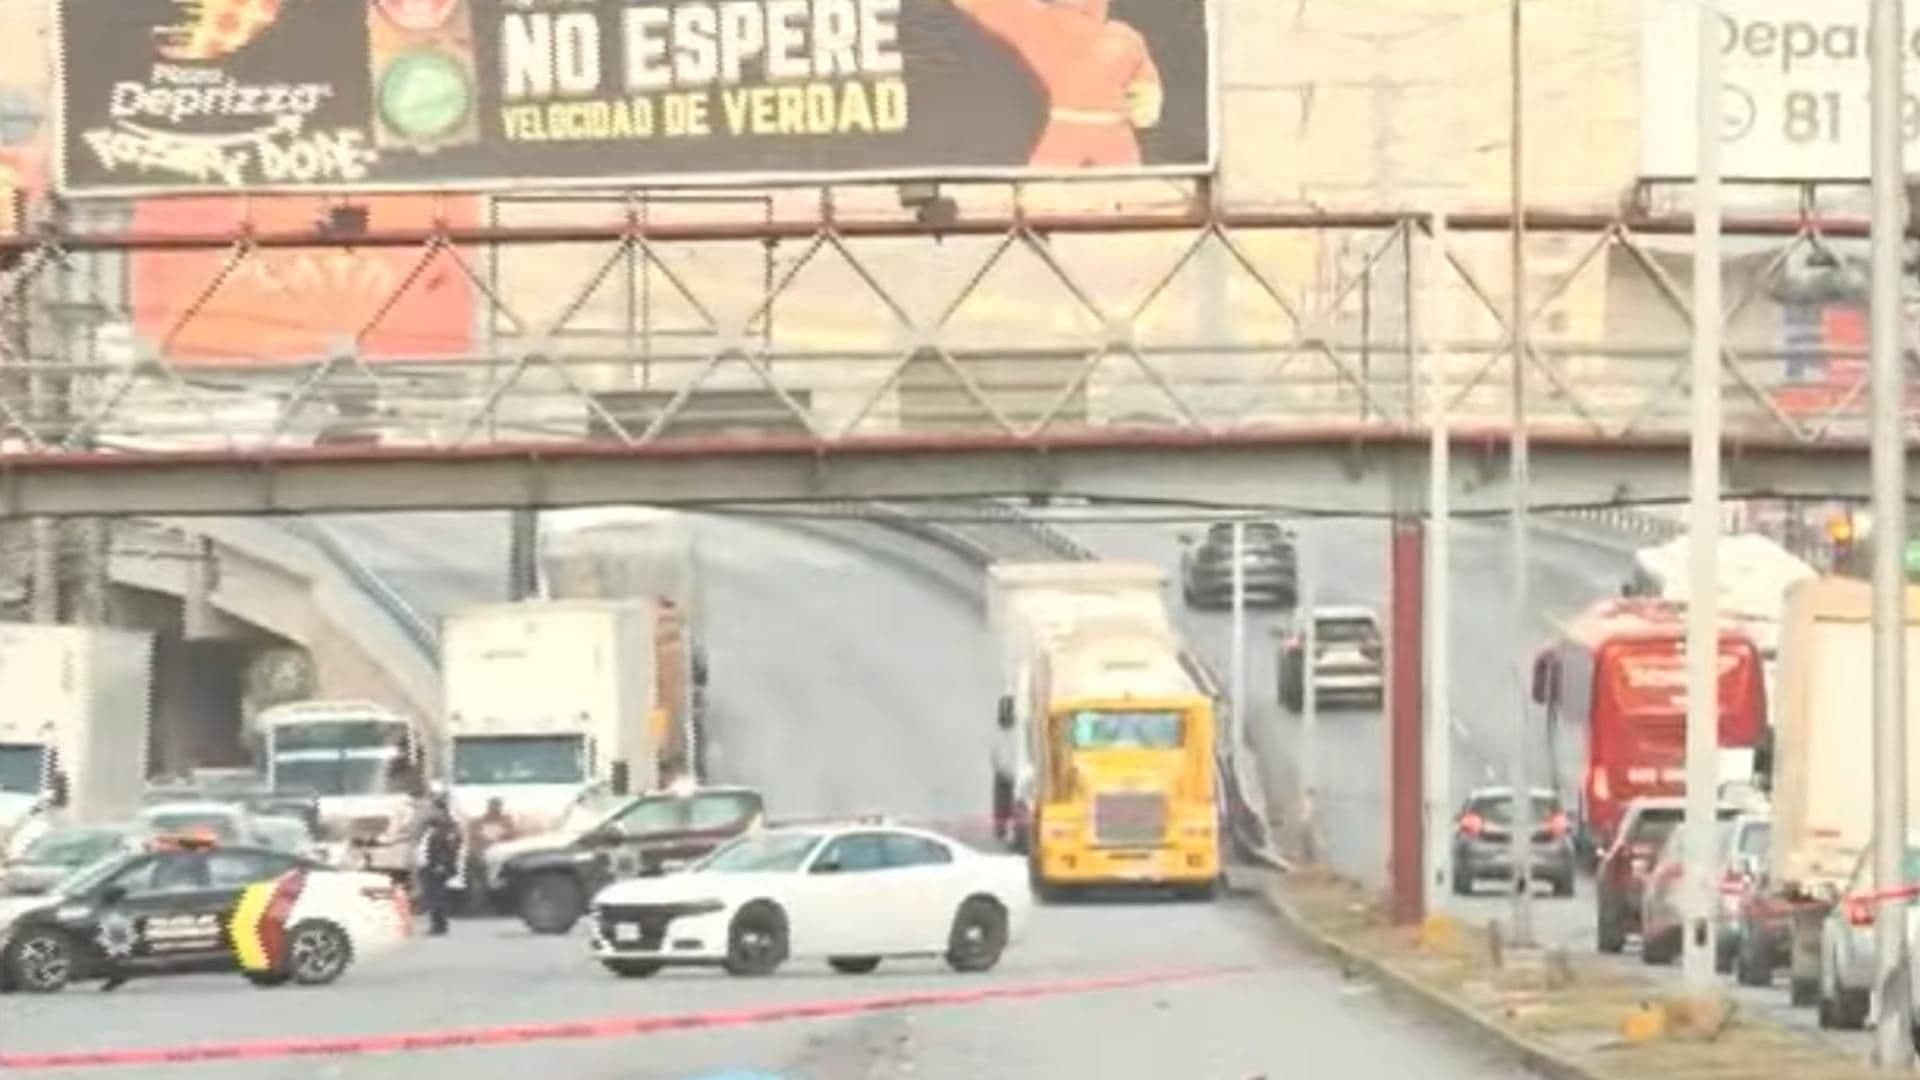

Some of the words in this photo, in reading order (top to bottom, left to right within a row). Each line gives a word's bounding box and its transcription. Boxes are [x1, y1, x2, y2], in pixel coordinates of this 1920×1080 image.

[504, 13, 600, 95] NO
[622, 0, 903, 90] ESPERE
[502, 98, 653, 140] VELOCIDAD
[664, 94, 710, 136] DE
[721, 78, 907, 135] VERDAD
[1783, 90, 1840, 143] 81
